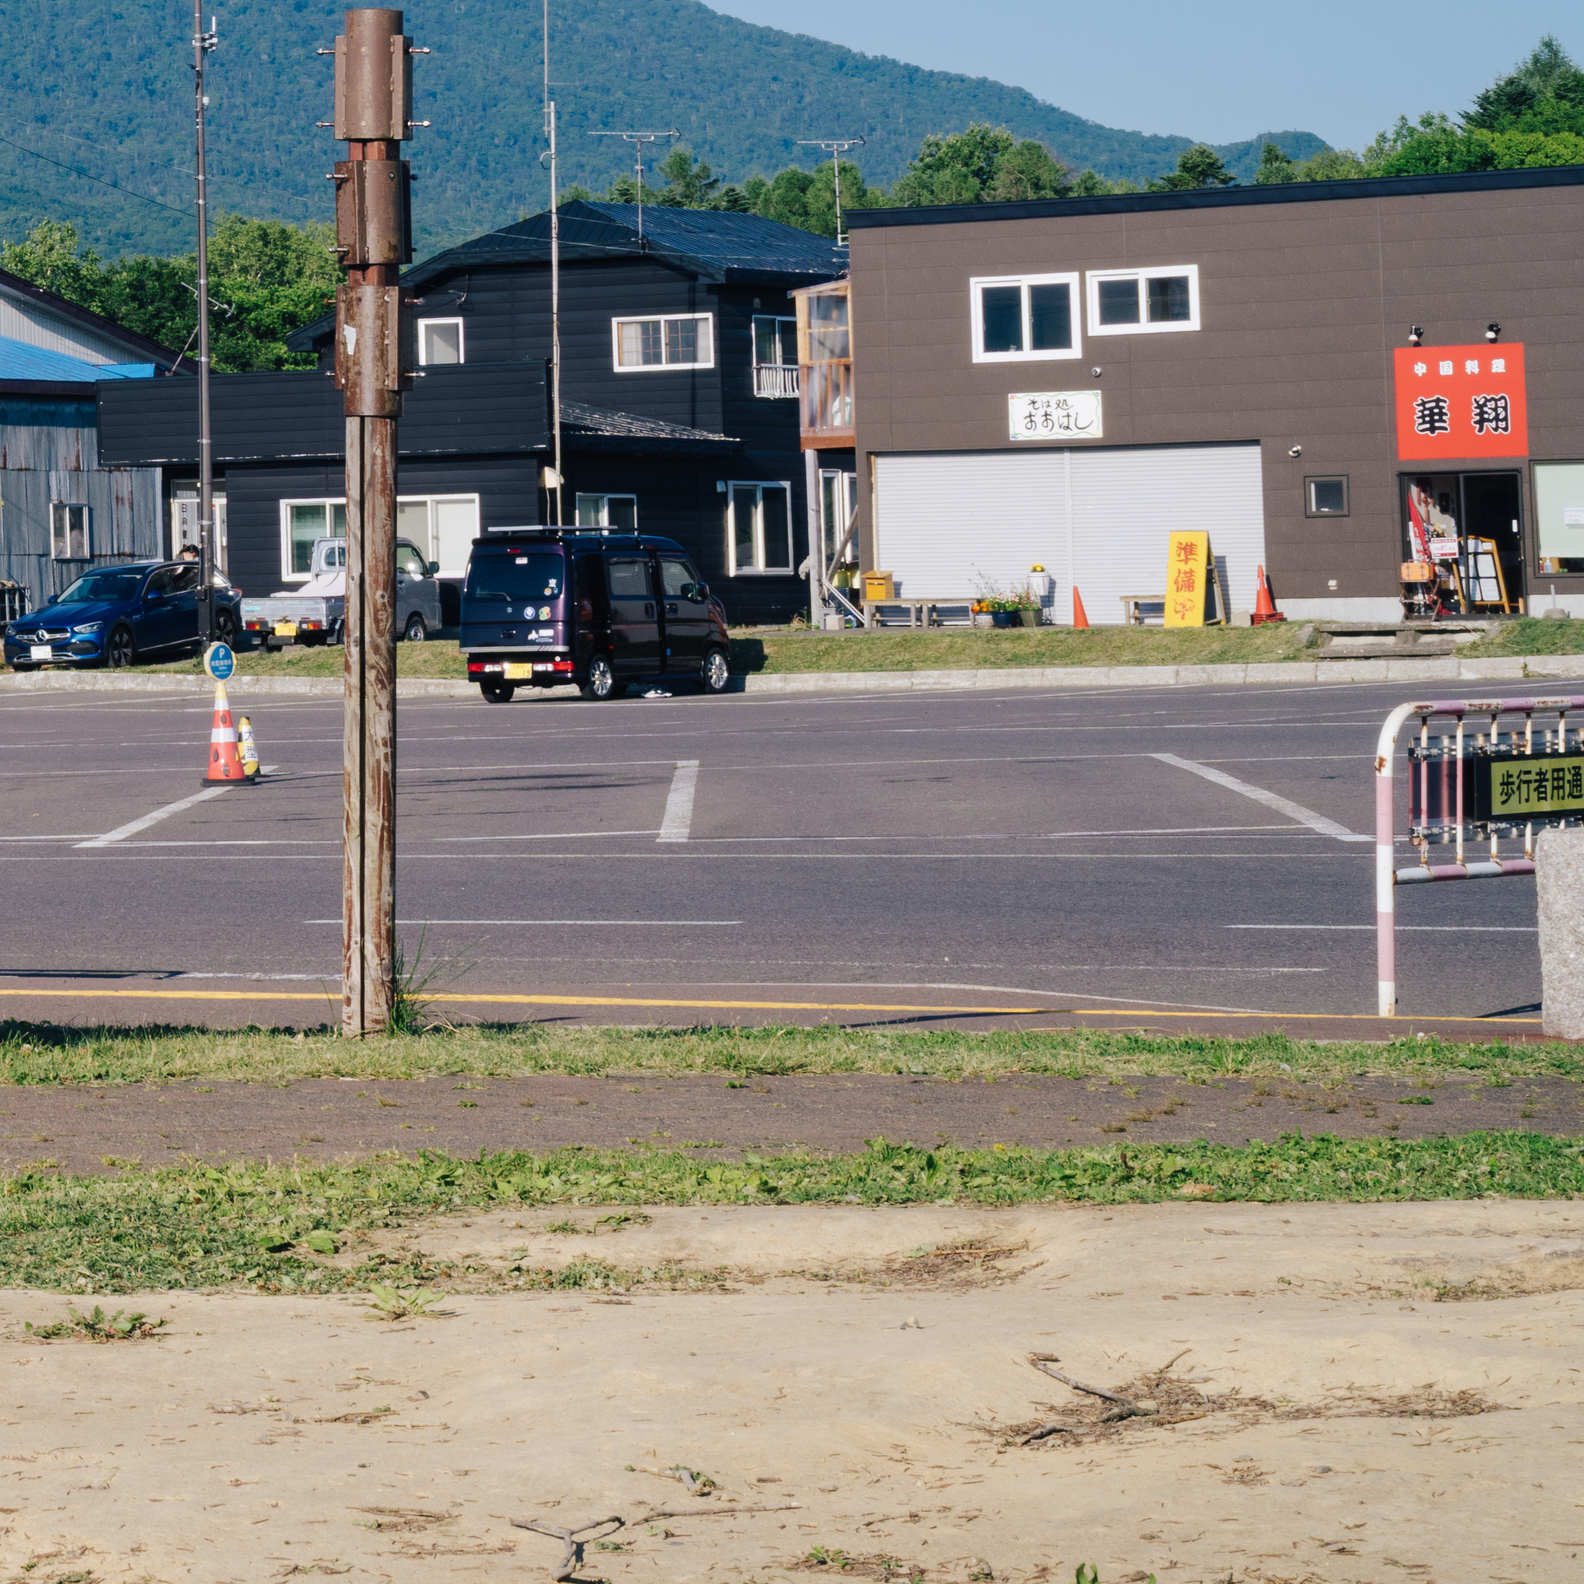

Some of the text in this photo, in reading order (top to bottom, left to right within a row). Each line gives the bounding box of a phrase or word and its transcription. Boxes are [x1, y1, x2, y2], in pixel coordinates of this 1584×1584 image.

[1414, 358, 1506, 377] 中国料理
[1028, 398, 1074, 411] そば処
[1413, 393, 1511, 436] 華翔
[1023, 410, 1094, 432] おおはし
[219, 647, 225, 659] P
[244, 729, 257, 758] 大型
[1499, 765, 1584, 806] 歩行者用通
